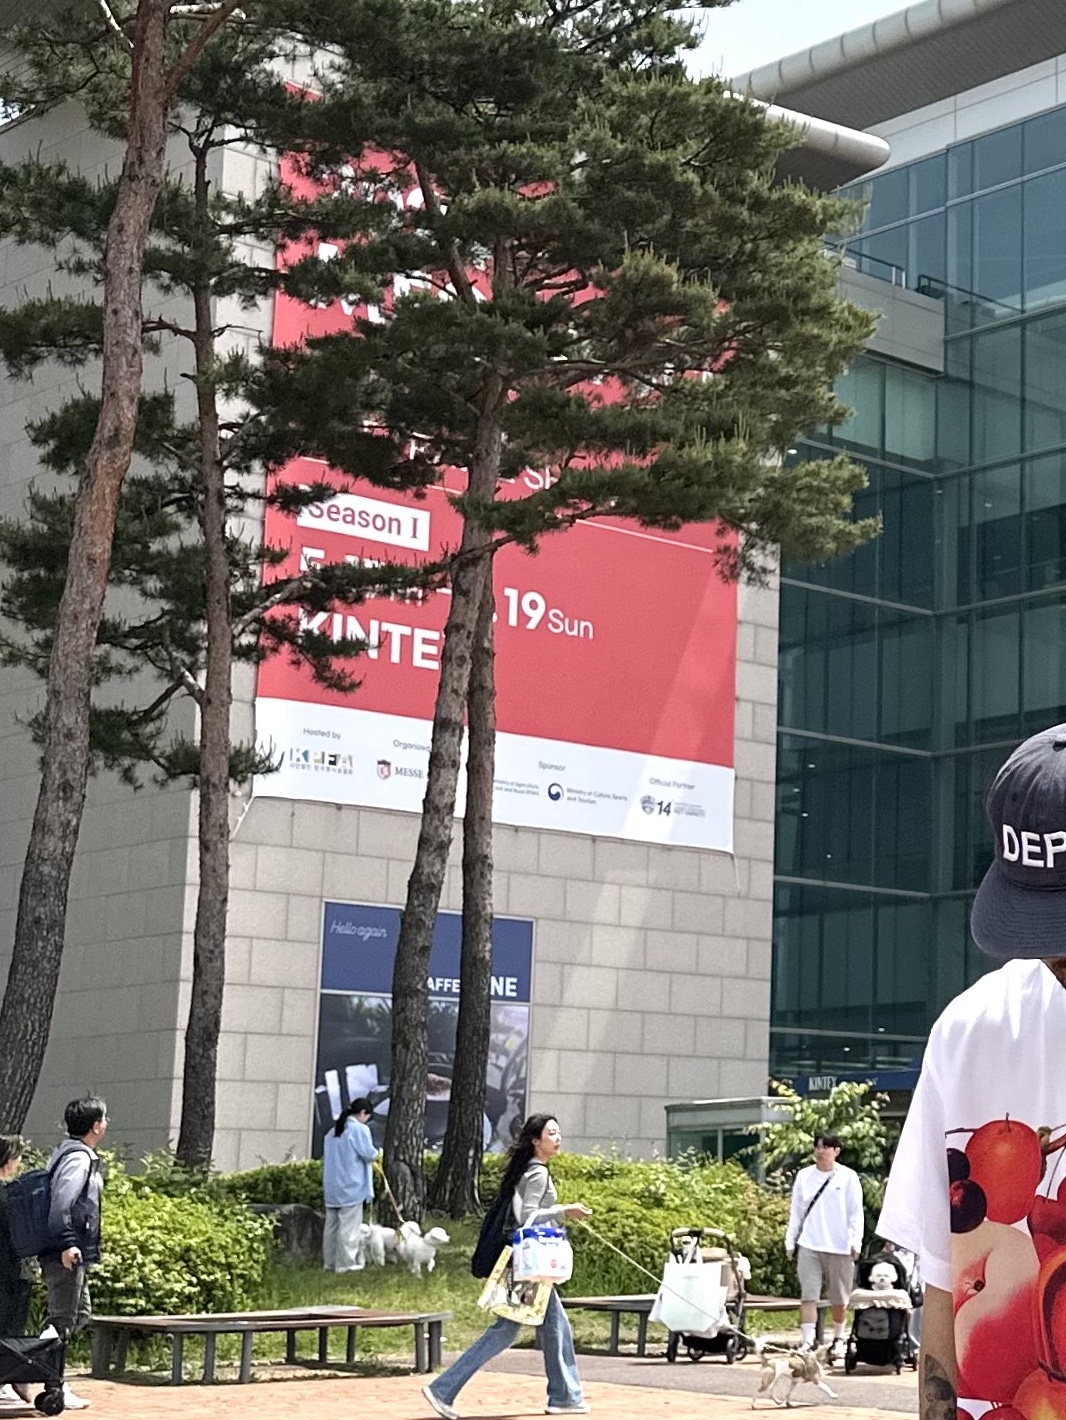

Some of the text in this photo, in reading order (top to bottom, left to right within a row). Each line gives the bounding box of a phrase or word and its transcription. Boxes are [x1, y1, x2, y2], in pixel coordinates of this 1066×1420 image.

[308, 502, 402, 536] Season
[299, 607, 445, 671] KINTE
[302, 728, 342, 740] Hosted by
[394, 766, 424, 779] MESSE
[538, 761, 566, 771] Sponsor
[657, 800, 672, 816] 14
[427, 975, 518, 997] AFFE NE
